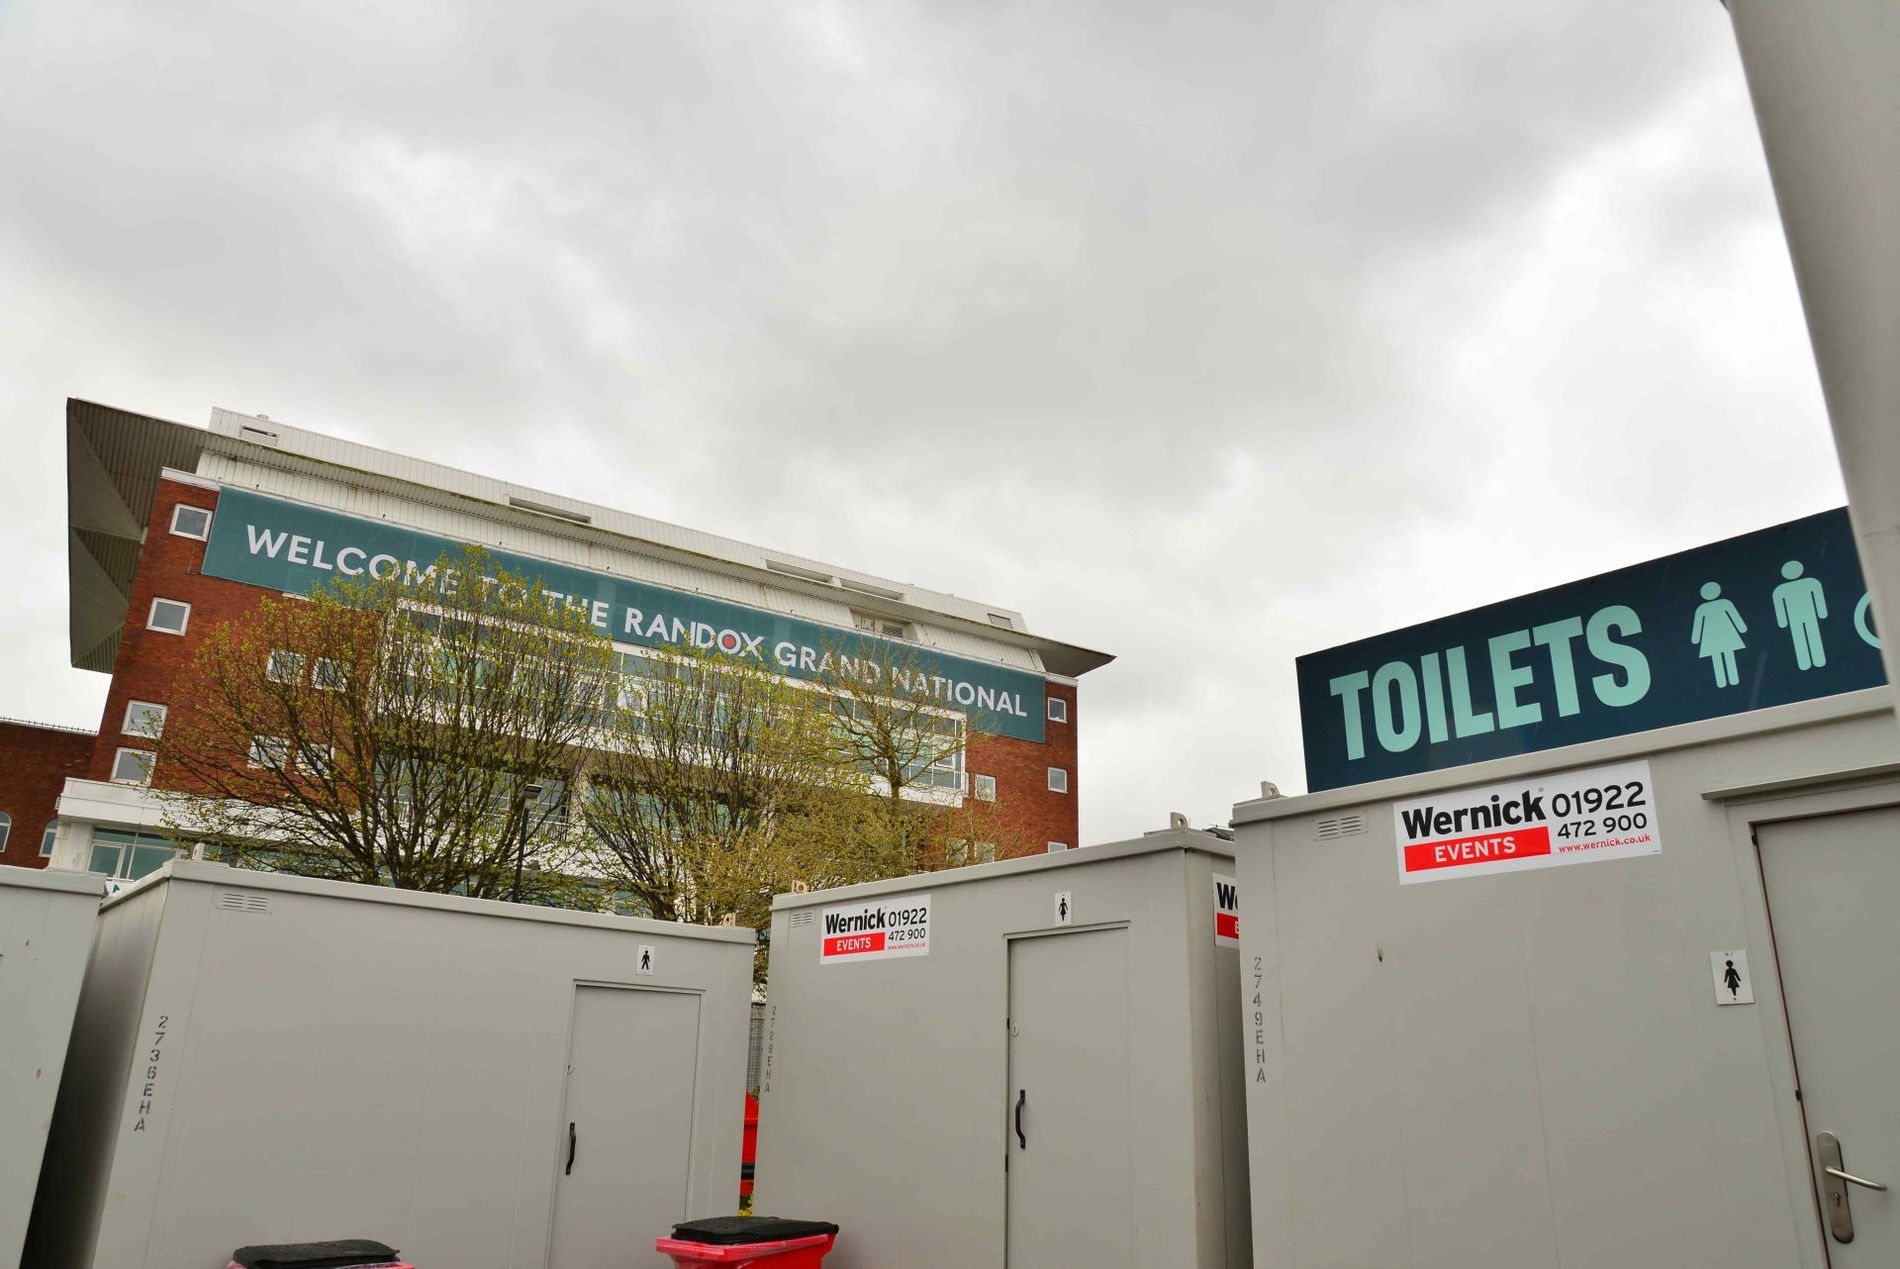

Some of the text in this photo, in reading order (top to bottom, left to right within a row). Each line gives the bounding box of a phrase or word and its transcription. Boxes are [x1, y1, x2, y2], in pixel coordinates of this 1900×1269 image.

[247, 524, 462, 595] WELCOME
[541, 589, 610, 628] THE
[624, 607, 765, 662] RANDOX
[774, 641, 882, 684] GRAND
[891, 666, 1028, 718] NATIONAL
[1329, 604, 1652, 761] TOILETS
[1401, 780, 1647, 840] Wernick 01922
[1556, 812, 1648, 840] 472 900
[1434, 836, 1517, 863] EVENTS
[1557, 834, 1652, 854] www.wernick.co.uk
[825, 906, 928, 935] Wernick 01922
[888, 927, 926, 942] 472 900
[836, 937, 871, 952] EVENTS
